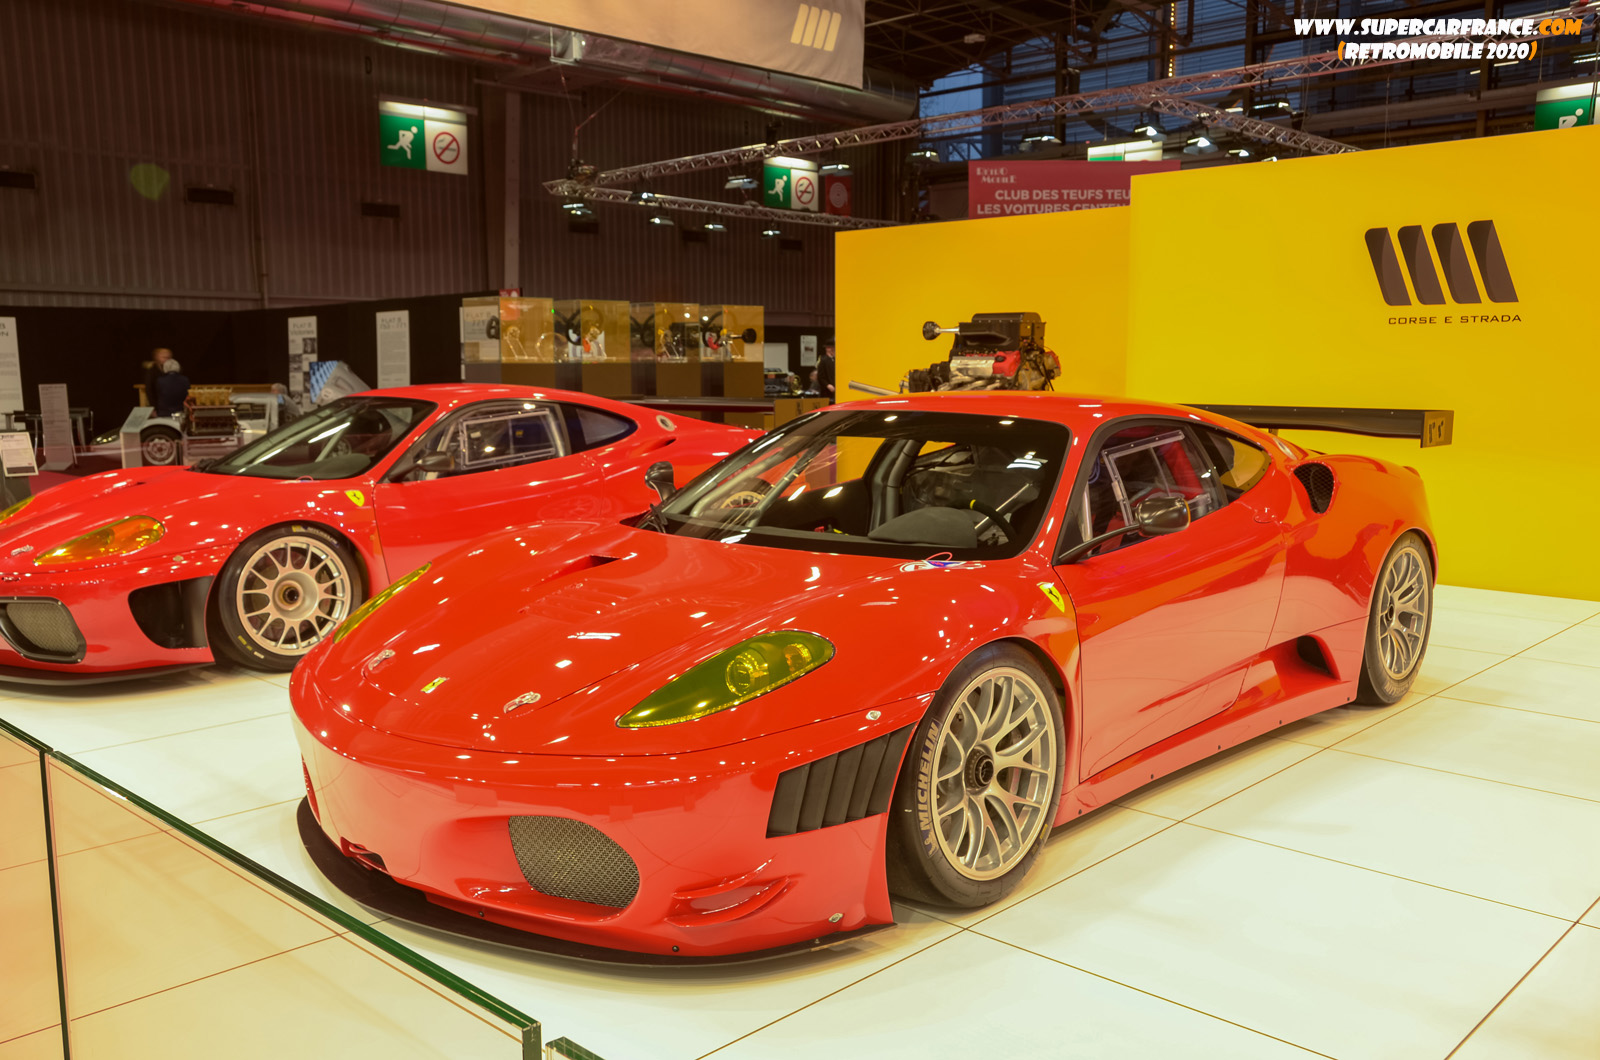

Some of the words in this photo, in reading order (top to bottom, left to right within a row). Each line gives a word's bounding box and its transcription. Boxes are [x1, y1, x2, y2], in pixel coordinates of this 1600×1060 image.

[995, 189, 1030, 200] CLUB
[1032, 189, 1059, 200] DES
[1061, 189, 1104, 200] TEUFS
[977, 203, 1001, 215] LES
[1003, 203, 1071, 214] VOITURES
[1388, 316, 1437, 325] CORSE
[1444, 315, 1453, 324] E
[1460, 314, 1522, 323] STRADA
[917, 721, 940, 831] MICHELIN
